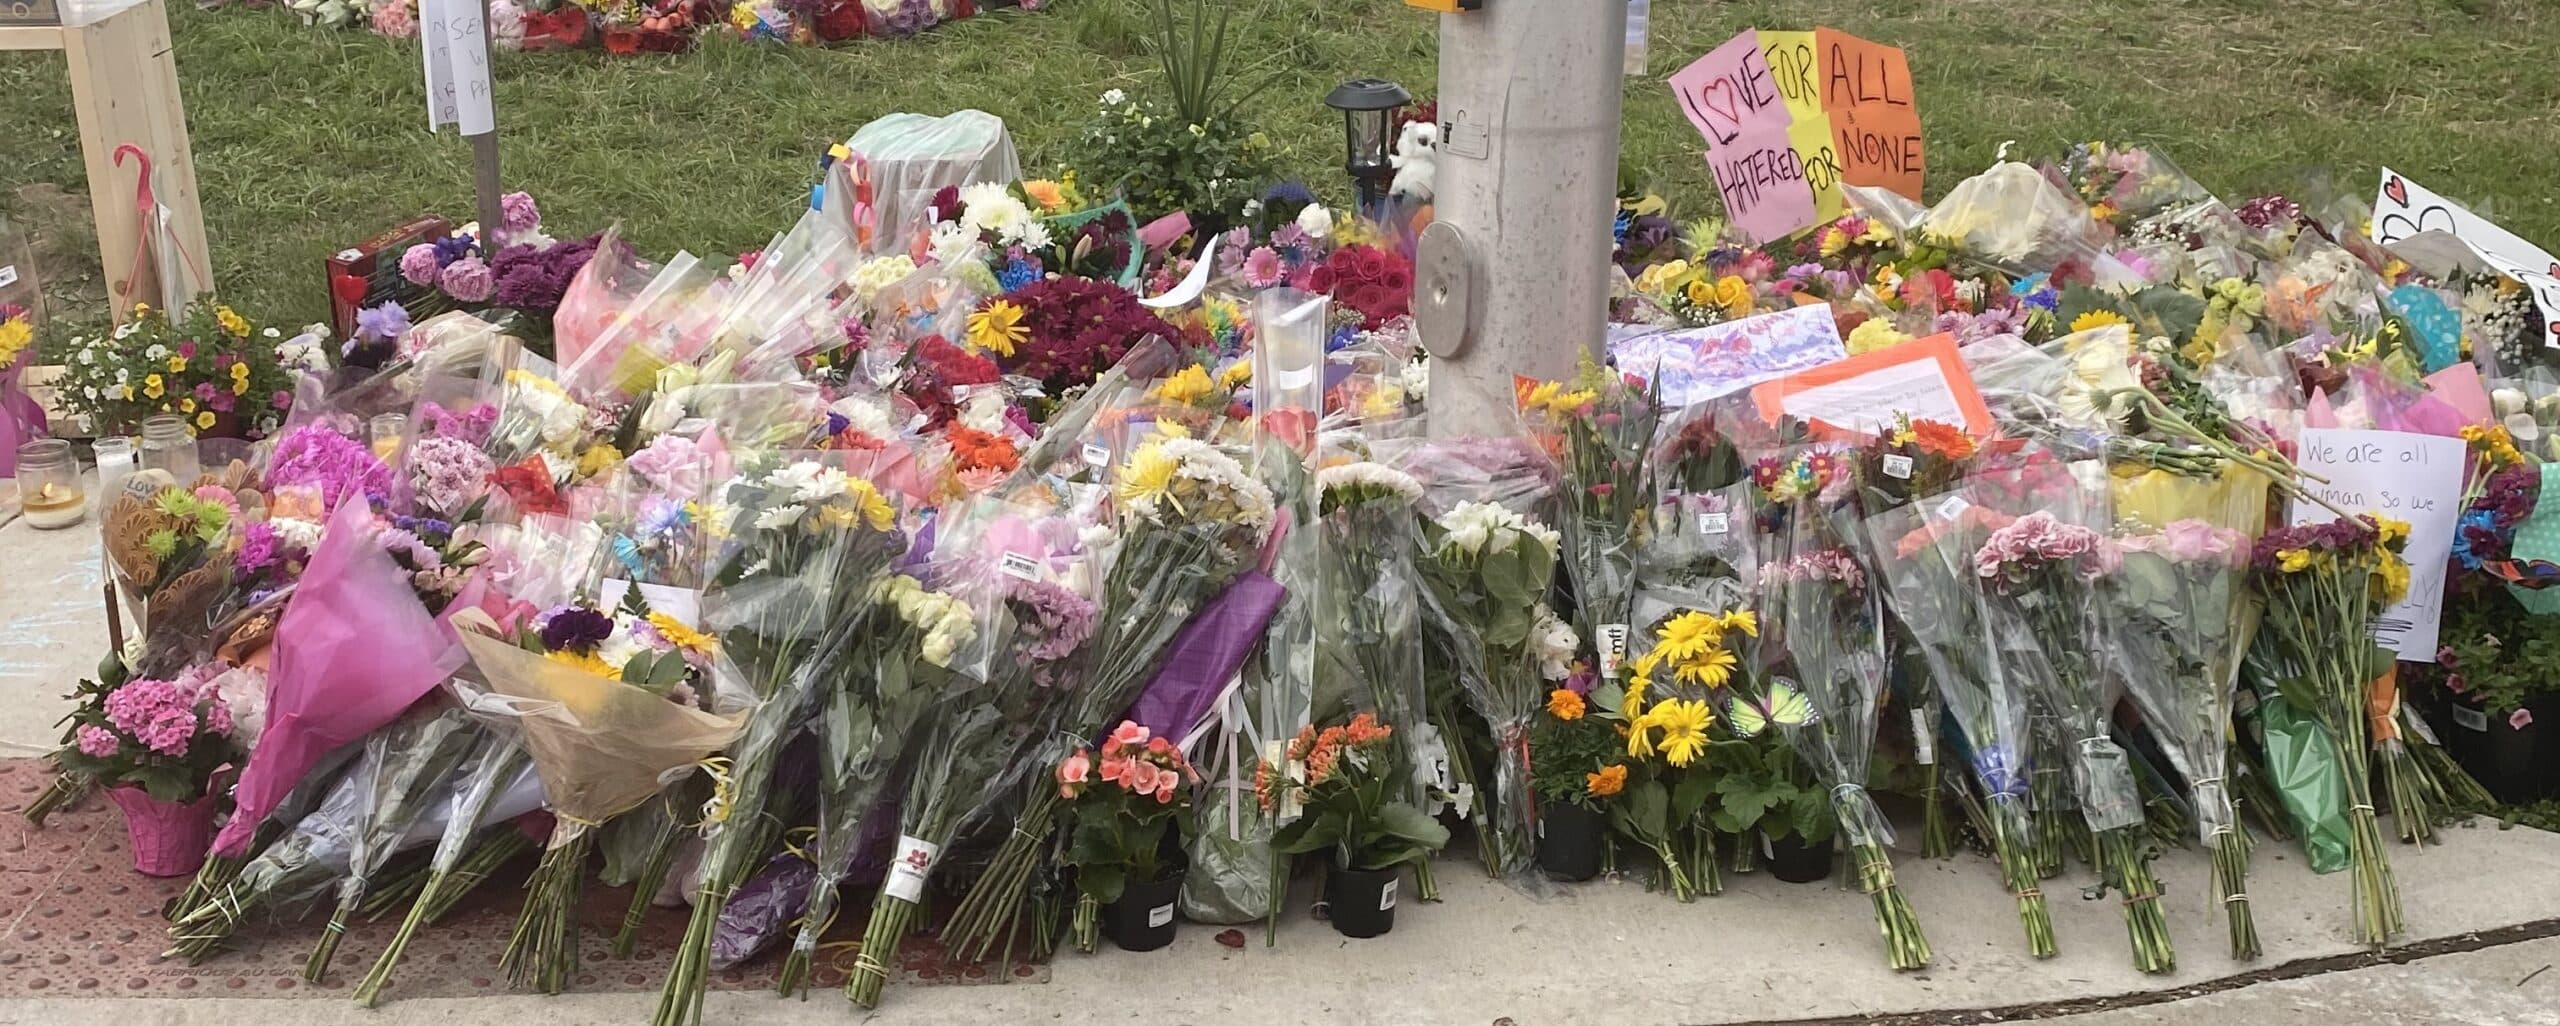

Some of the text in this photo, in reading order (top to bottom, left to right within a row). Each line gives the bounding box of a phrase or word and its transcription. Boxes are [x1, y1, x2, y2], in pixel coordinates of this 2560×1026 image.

[1764, 43, 1816, 105] FOR
[1831, 43, 1908, 107] ALL
[1715, 128, 1921, 220] HATERED FOR NONE
[2305, 436, 2428, 464] We are all
[126, 475, 157, 494] LOV
[2412, 496, 2434, 511] we
[239, 968, 264, 977] AU
[269, 968, 341, 977] CANA
